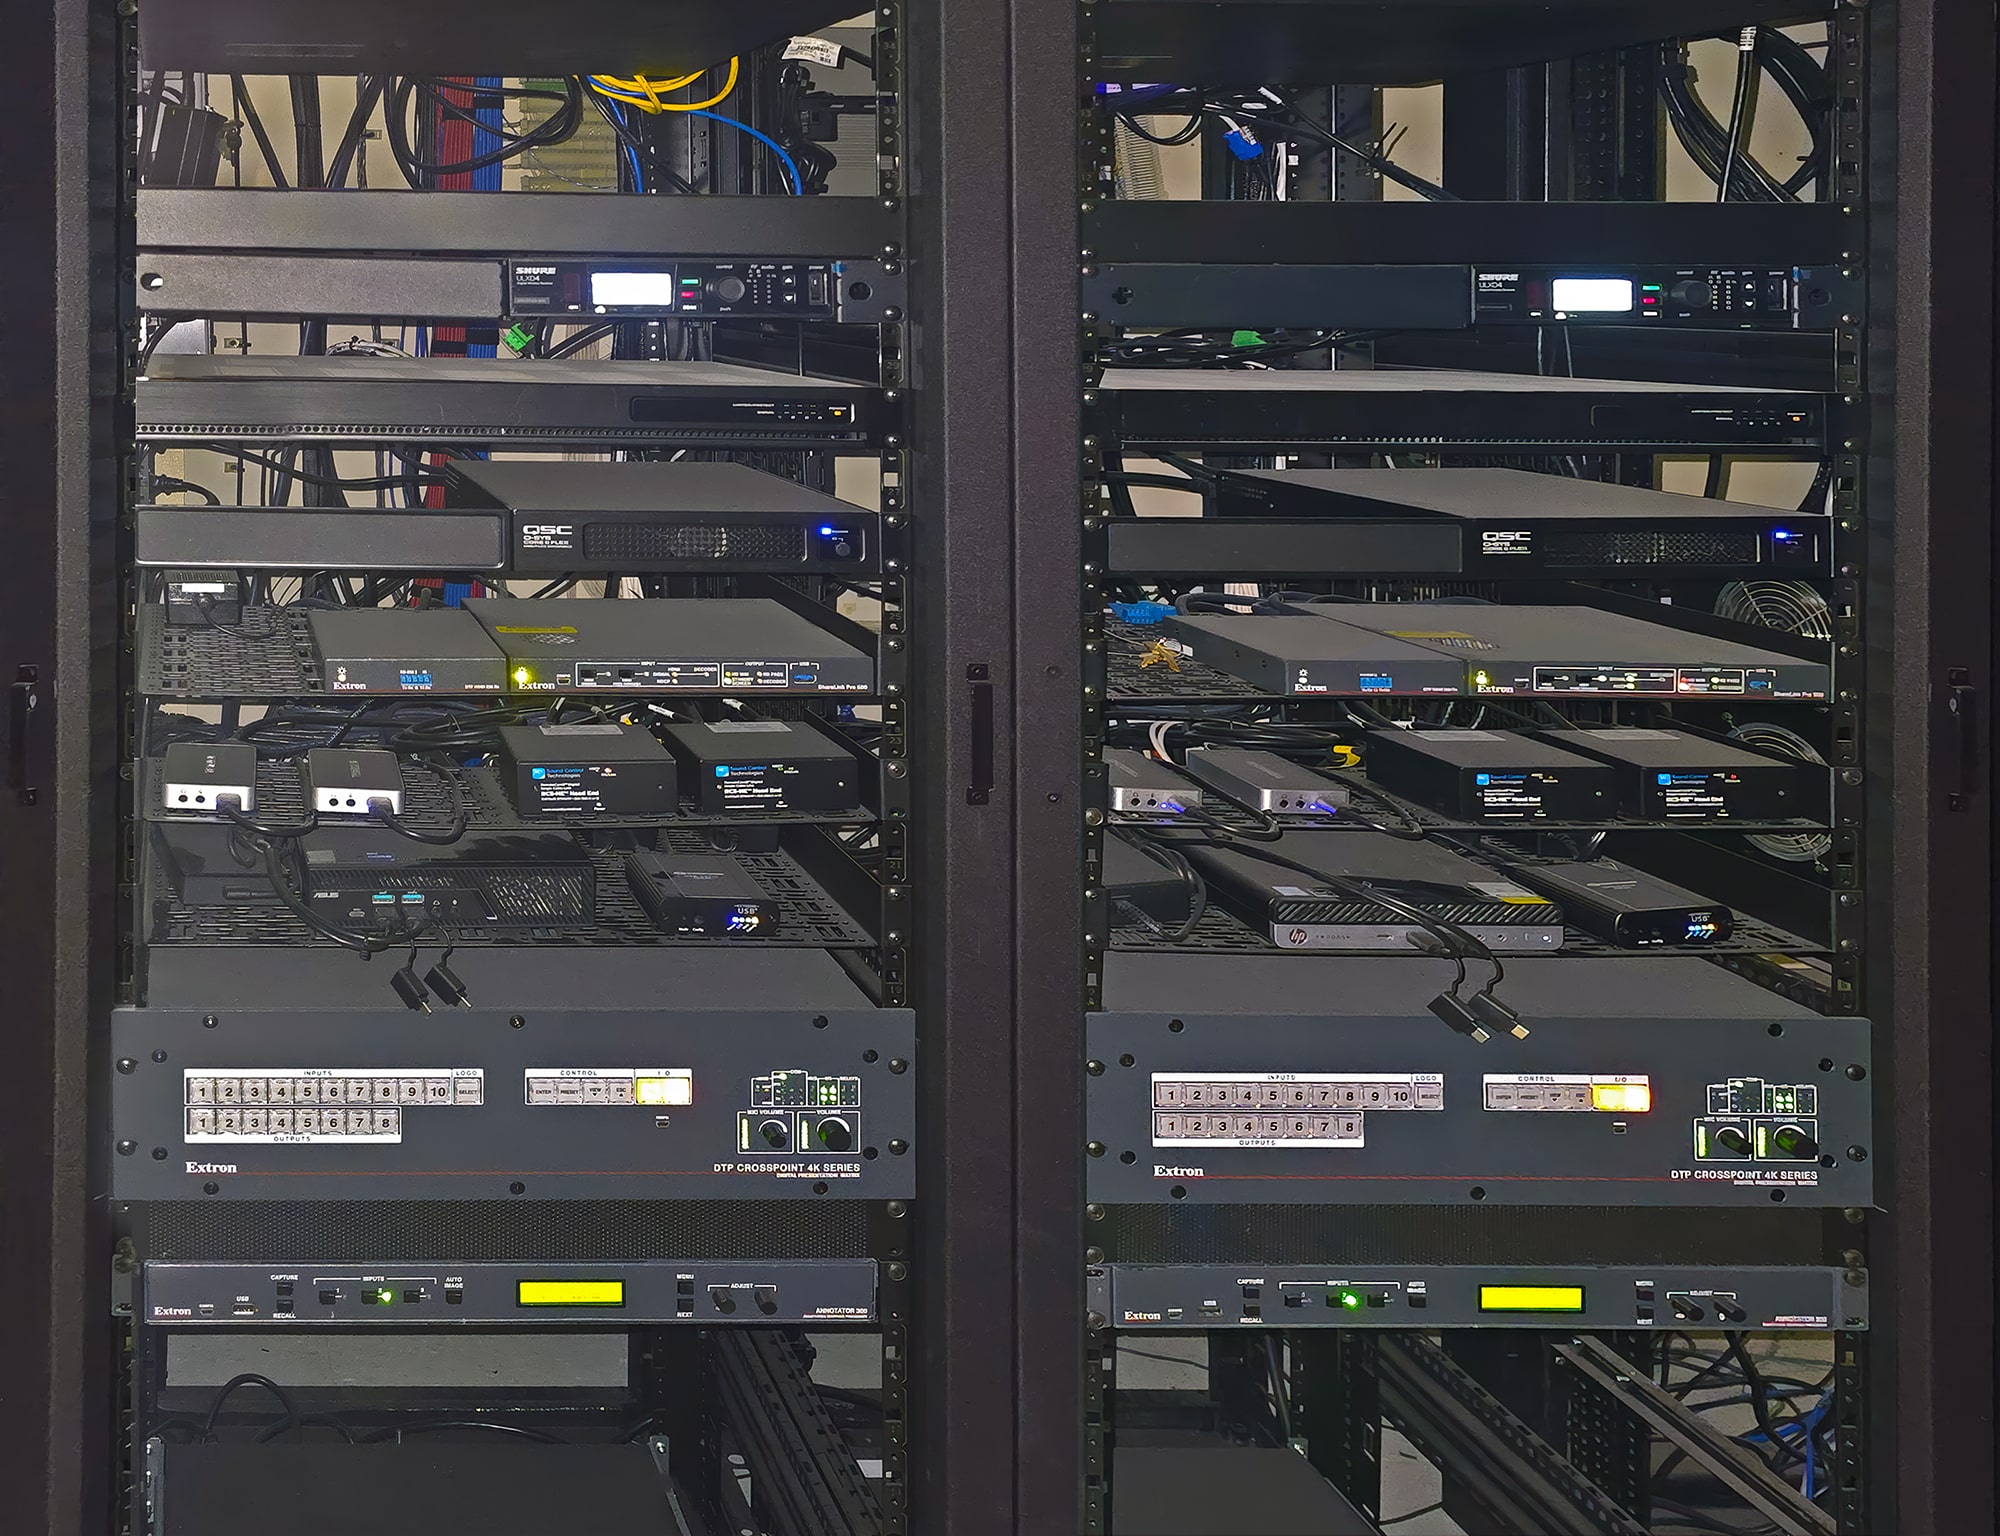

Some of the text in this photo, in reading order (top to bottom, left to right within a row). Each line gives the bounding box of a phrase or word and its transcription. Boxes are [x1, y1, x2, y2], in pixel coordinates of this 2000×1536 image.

[515, 267, 557, 275] SHURE
[522, 525, 572, 535] QSC
[1482, 532, 1532, 542] QSC
[333, 682, 366, 690] Extron
[518, 681, 556, 690] Extron
[1294, 684, 1328, 692] Extron
[1477, 684, 1514, 694] Extron
[1290, 928, 1308, 945] hp
[200, 1088, 446, 1096] 1 2 3 4 5 6 7 8 9 10
[1168, 1092, 1408, 1100] 1 2 3 4 5 6 7 8 9 10
[200, 1119, 390, 1127] 1 2 3 4 5 6 7 8
[1168, 1122, 1354, 1131] 1 2 3 4 5 6 7 8
[185, 1161, 237, 1173] Extron
[713, 1164, 860, 1172] DTP CROSSPOINT 4K SERIES
[1153, 1165, 1204, 1177] Extron
[1671, 1170, 1818, 1180] DTP CROSSPOINT 4K SERIES
[154, 1306, 192, 1316] Extron
[1124, 1311, 1161, 1320] Extron
